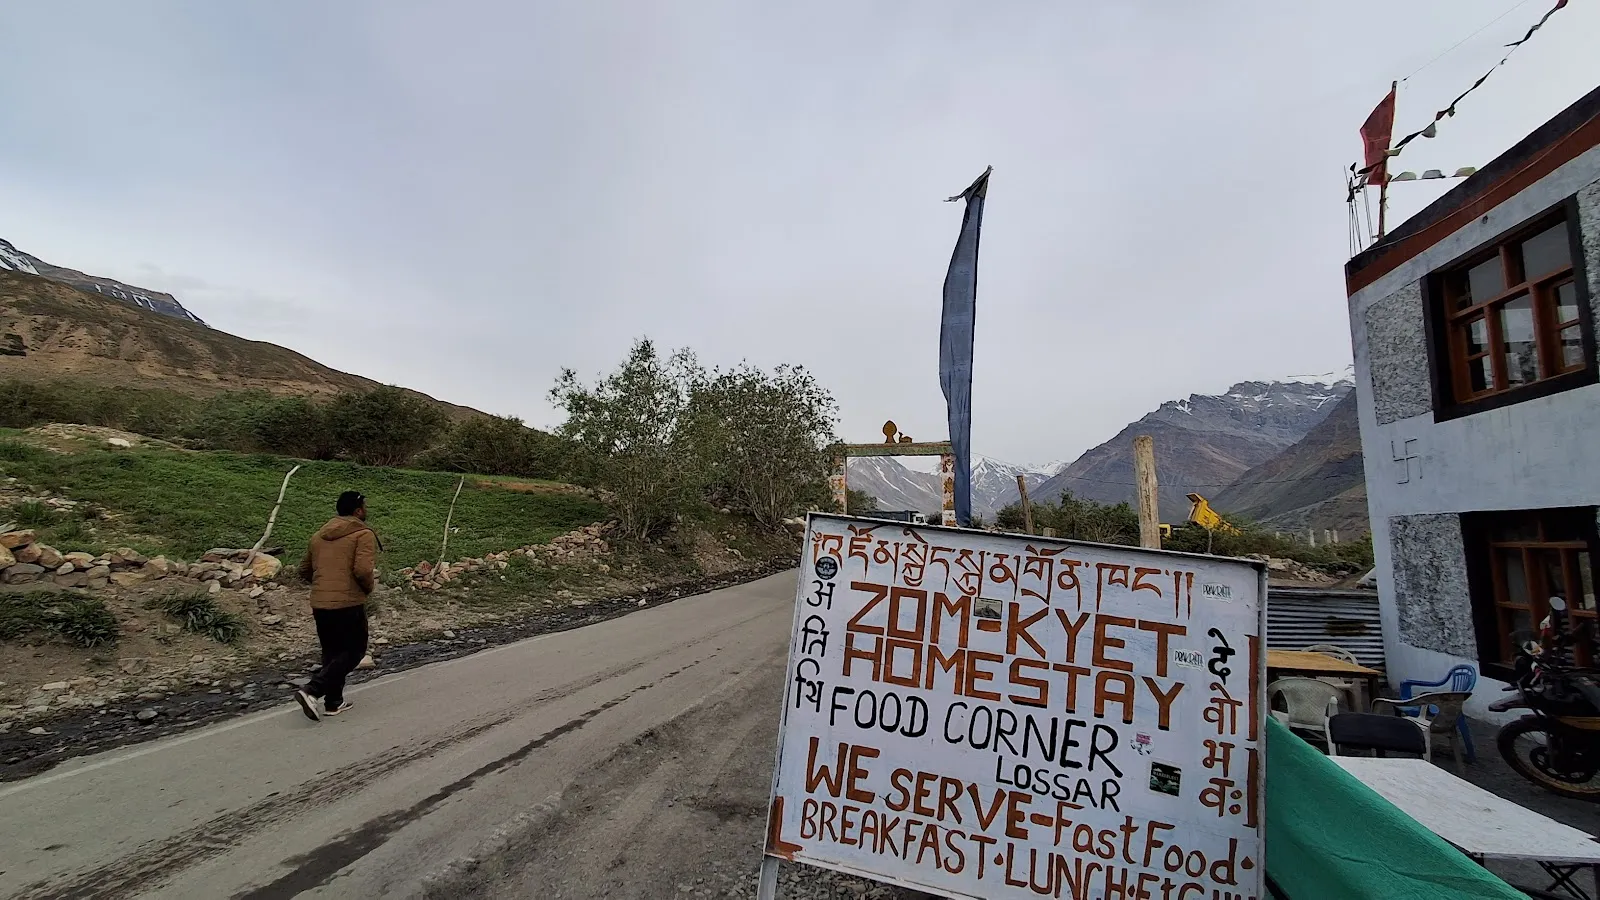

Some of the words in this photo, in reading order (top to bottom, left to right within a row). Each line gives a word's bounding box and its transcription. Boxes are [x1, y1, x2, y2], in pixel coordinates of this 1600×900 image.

[847, 580, 1187, 677] ZOM-KYET
[841, 632, 1185, 732] HOMESTAY
[805, 736, 881, 805] WE
[829, 686, 929, 738] FOOD
[943, 701, 1124, 779] CORNER
[995, 755, 1121, 813] LOSSAR
